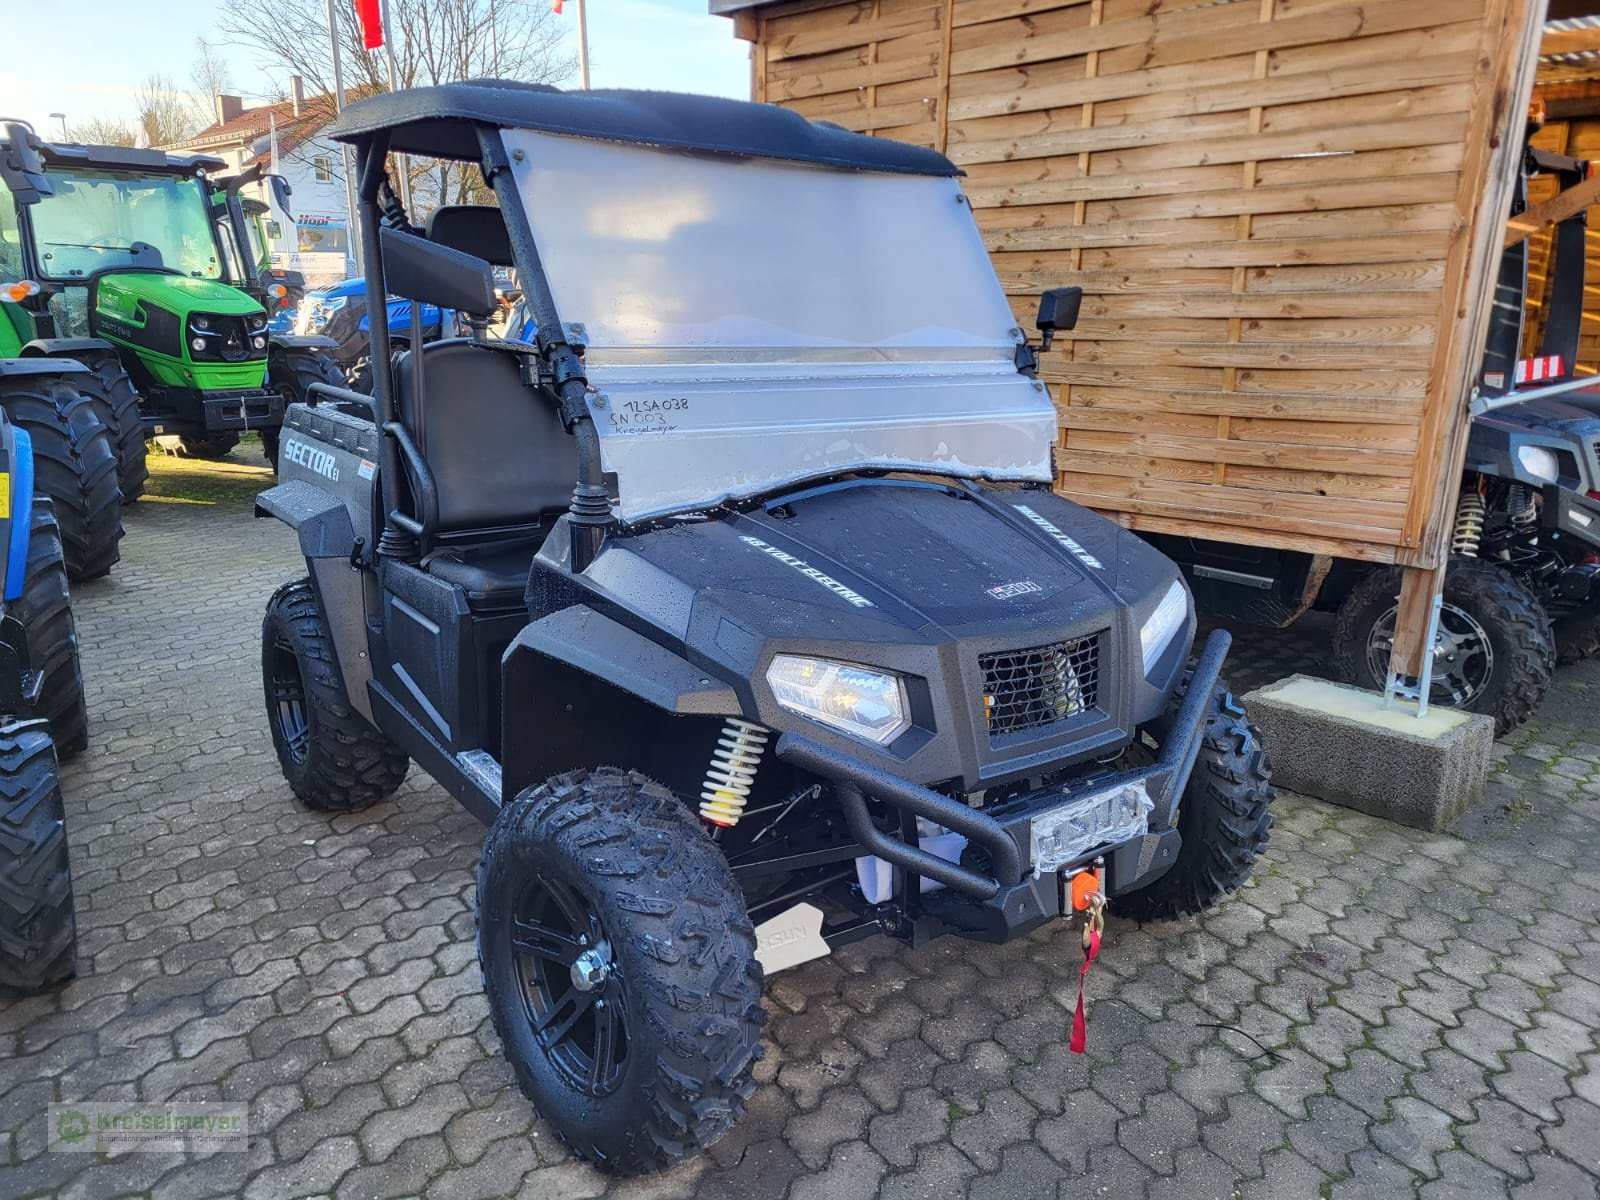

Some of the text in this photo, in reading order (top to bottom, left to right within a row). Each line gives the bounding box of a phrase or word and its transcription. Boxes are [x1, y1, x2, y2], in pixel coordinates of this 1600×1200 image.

[608, 412, 667, 426] SN 003
[284, 438, 336, 480] SECTOR
[737, 535, 875, 608] 48 VOLT ELECTRIC
